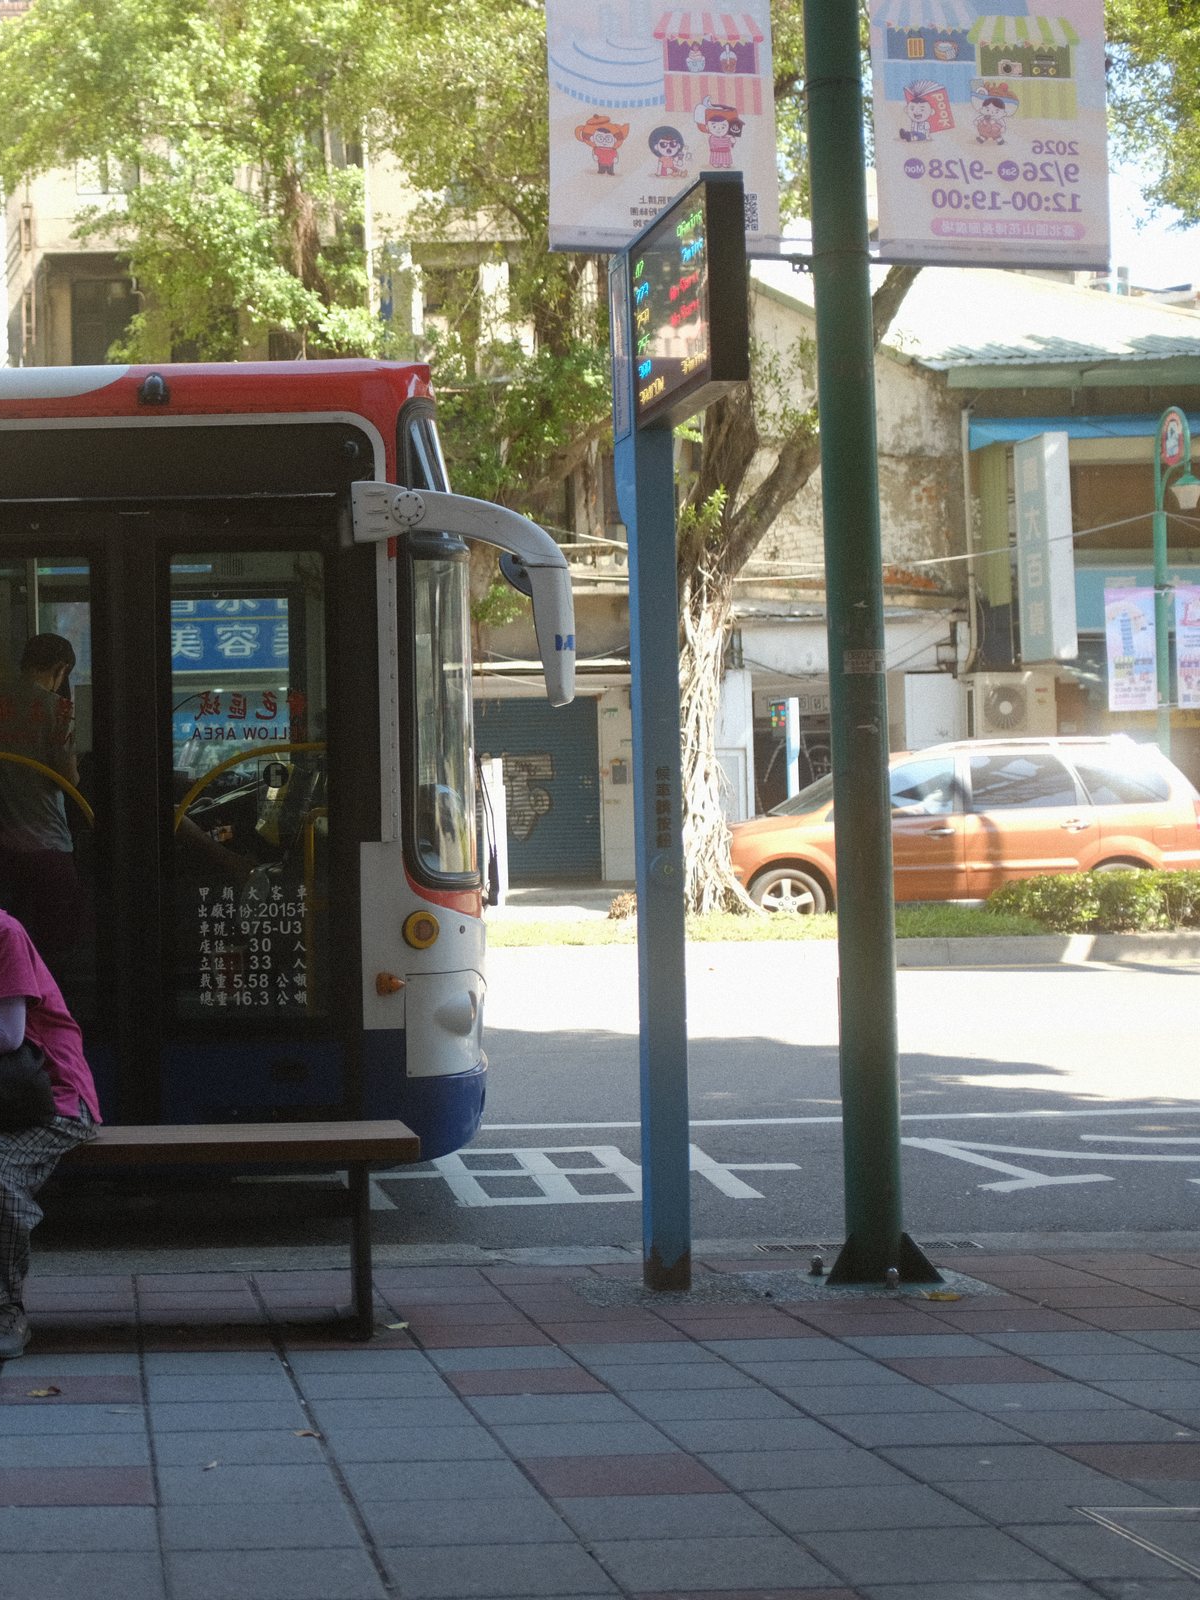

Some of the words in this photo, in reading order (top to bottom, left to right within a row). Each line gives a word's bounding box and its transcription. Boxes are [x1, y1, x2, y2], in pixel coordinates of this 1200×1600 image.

[240, 920, 303, 935] 975-U3
[249, 938, 272, 952] 30
[293, 941, 307, 952] 人
[249, 955, 272, 969] 33
[293, 958, 307, 969] 人
[233, 974, 269, 988] 5.58
[233, 991, 269, 1006] 16.3
